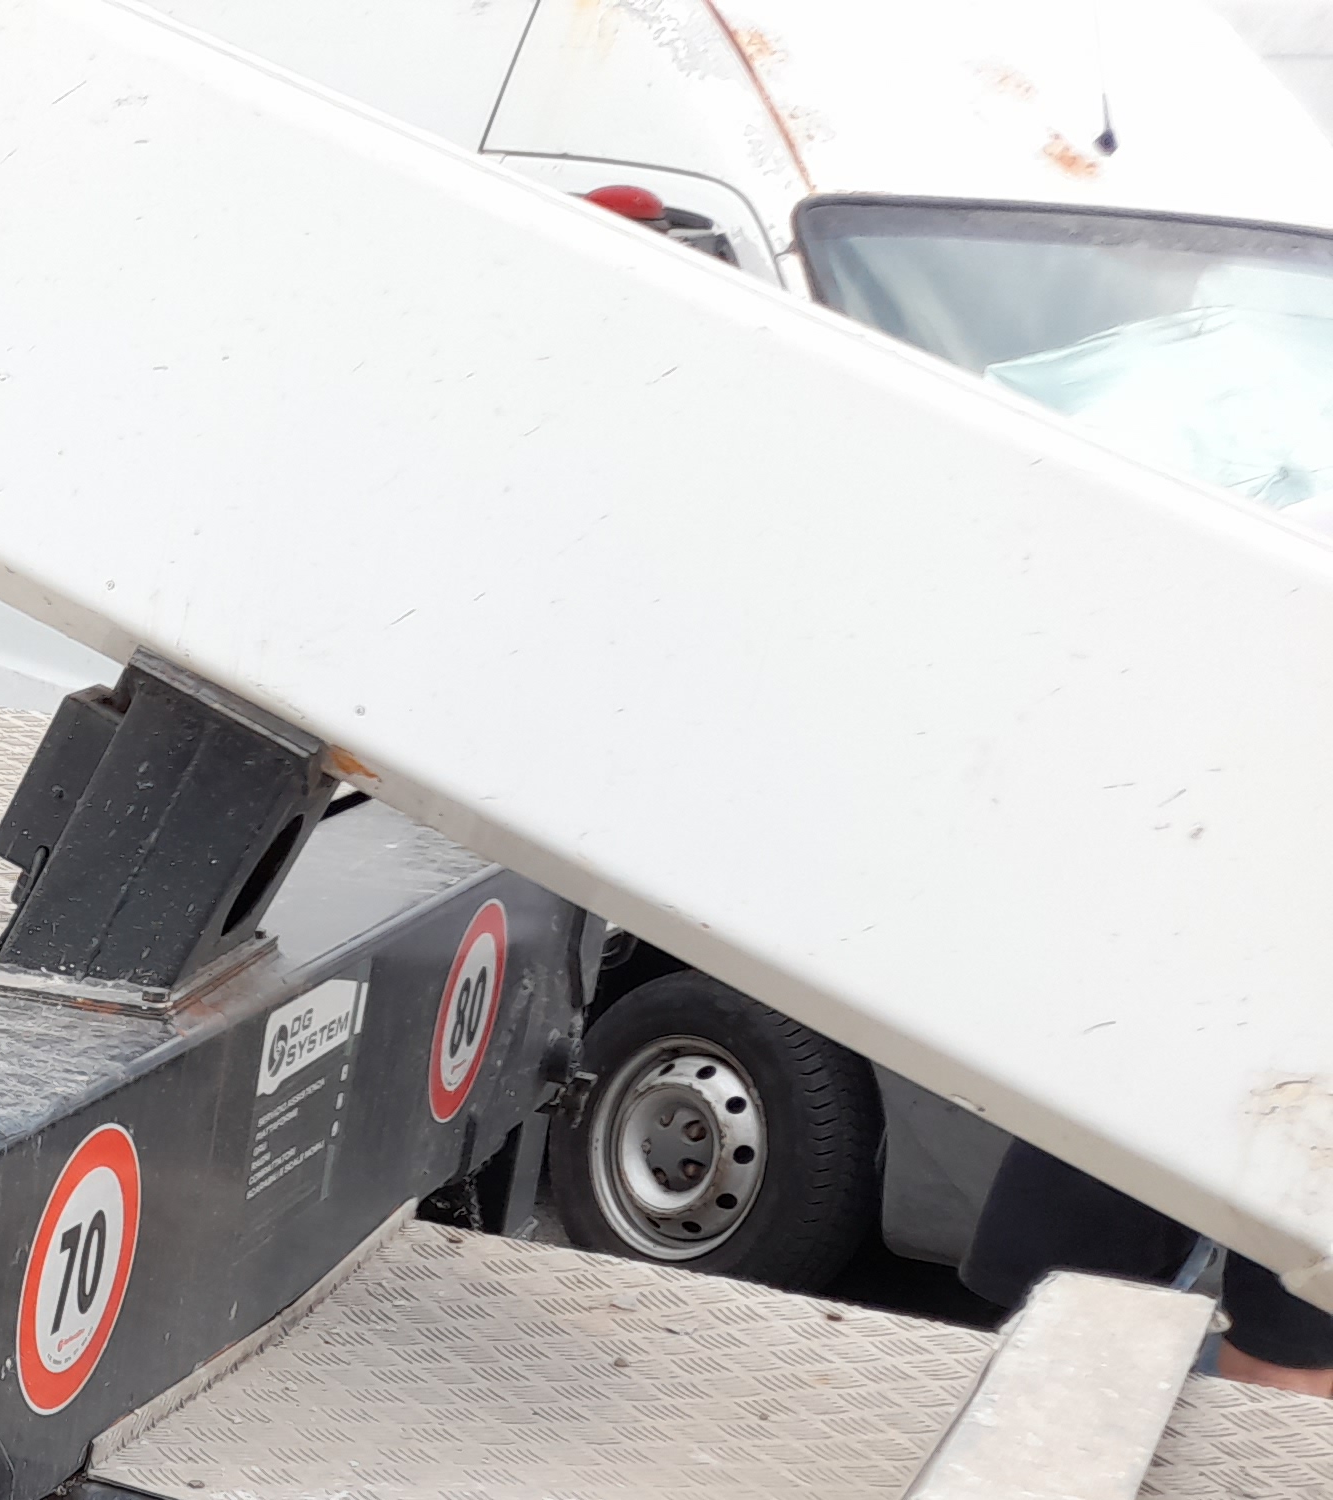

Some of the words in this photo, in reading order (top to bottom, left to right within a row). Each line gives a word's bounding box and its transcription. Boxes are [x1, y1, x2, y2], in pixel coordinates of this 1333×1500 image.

[286, 1010, 350, 1067] SYSTEM
[290, 1007, 314, 1039] DG
[449, 965, 487, 1059] 80
[50, 1209, 107, 1337] 70
